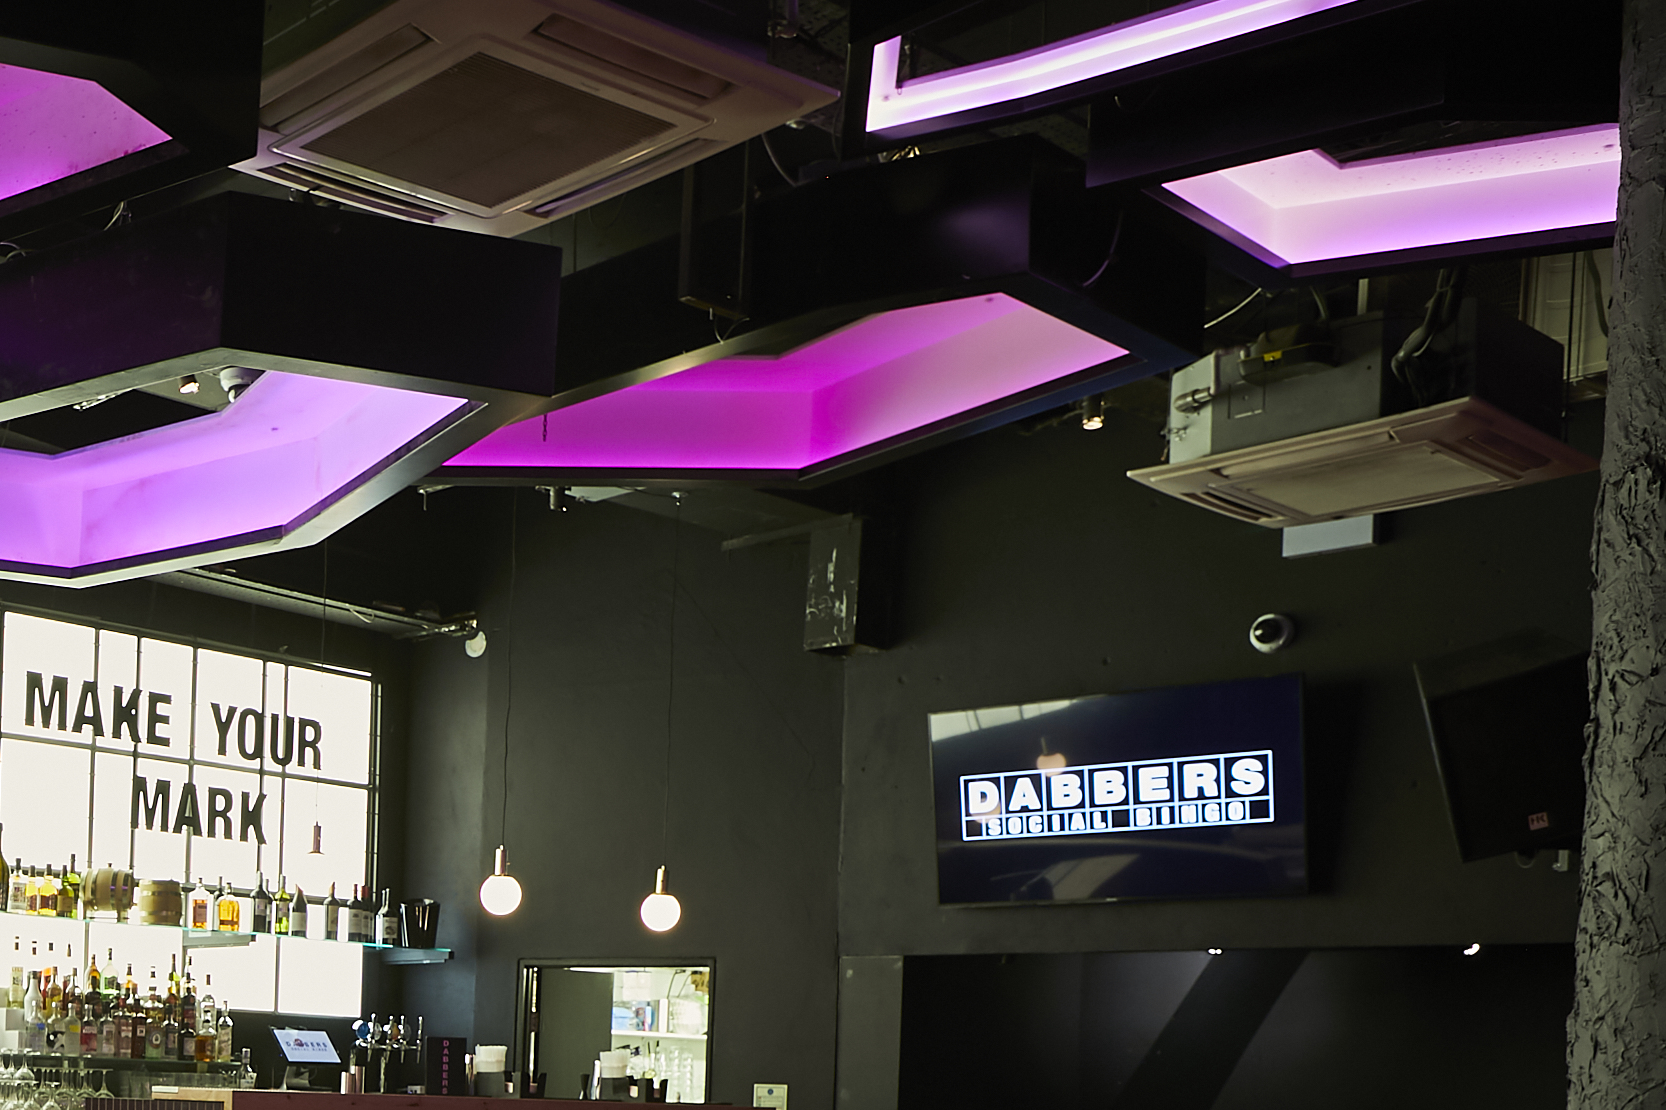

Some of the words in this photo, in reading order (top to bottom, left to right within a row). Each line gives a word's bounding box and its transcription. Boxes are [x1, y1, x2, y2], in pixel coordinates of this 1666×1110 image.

[25, 671, 172, 748] MAKE
[210, 702, 322, 771] YOUR
[134, 776, 268, 845] MARK
[968, 758, 1265, 815] DABBERS
[987, 811, 1107, 836] SOCIAL
[1135, 801, 1245, 827] BINGO
